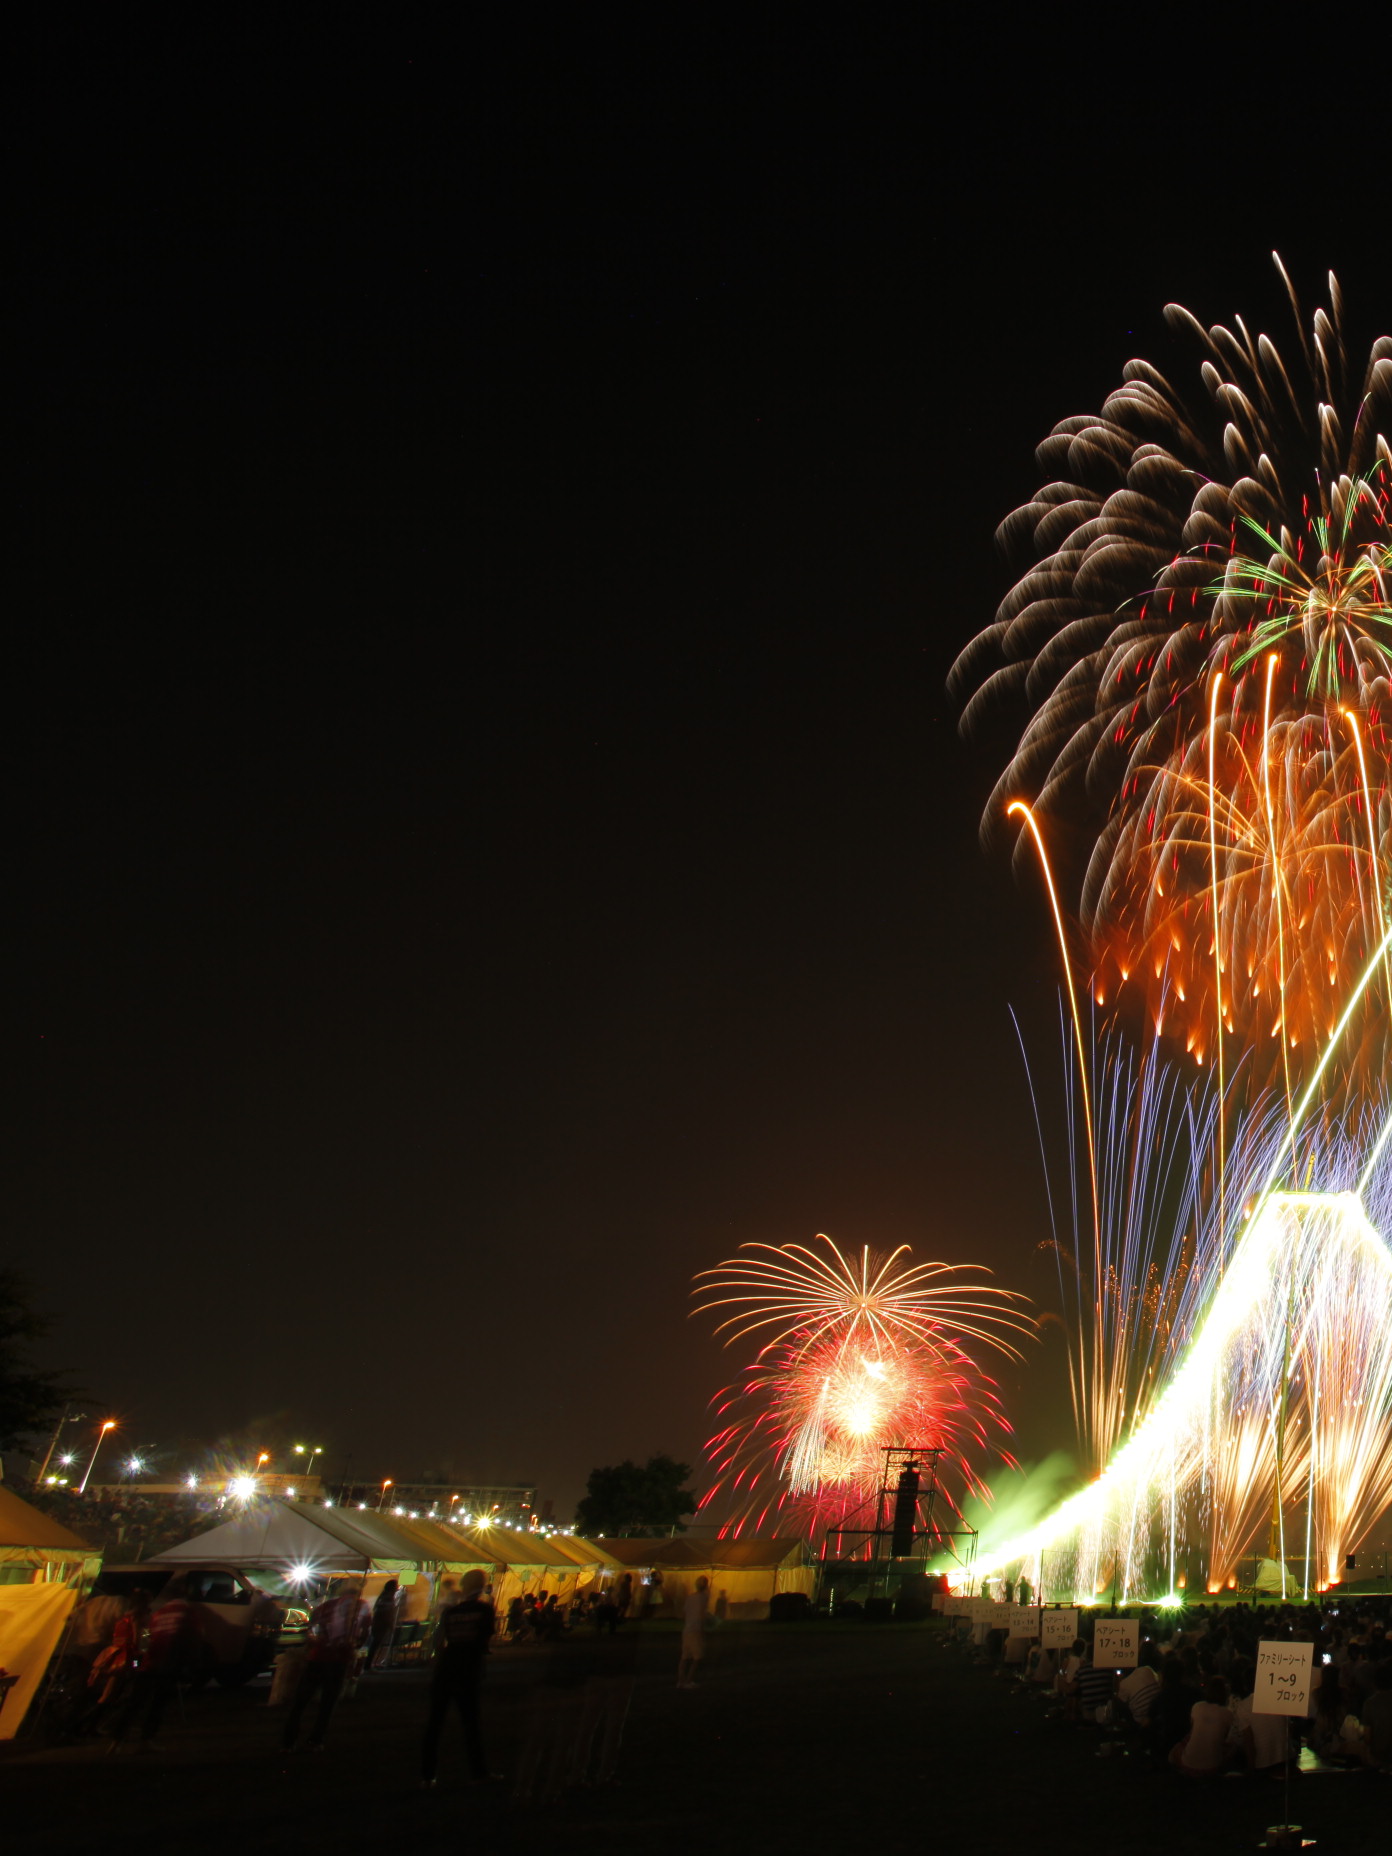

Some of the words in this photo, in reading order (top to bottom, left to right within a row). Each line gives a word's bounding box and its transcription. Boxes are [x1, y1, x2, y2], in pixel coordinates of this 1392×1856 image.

[1096, 1626, 1126, 1635] ペアシート
[1112, 1650, 1135, 1658] ブロック
[1259, 1653, 1306, 1667] ファミリーシート
[1276, 1689, 1305, 1702] ブロック
